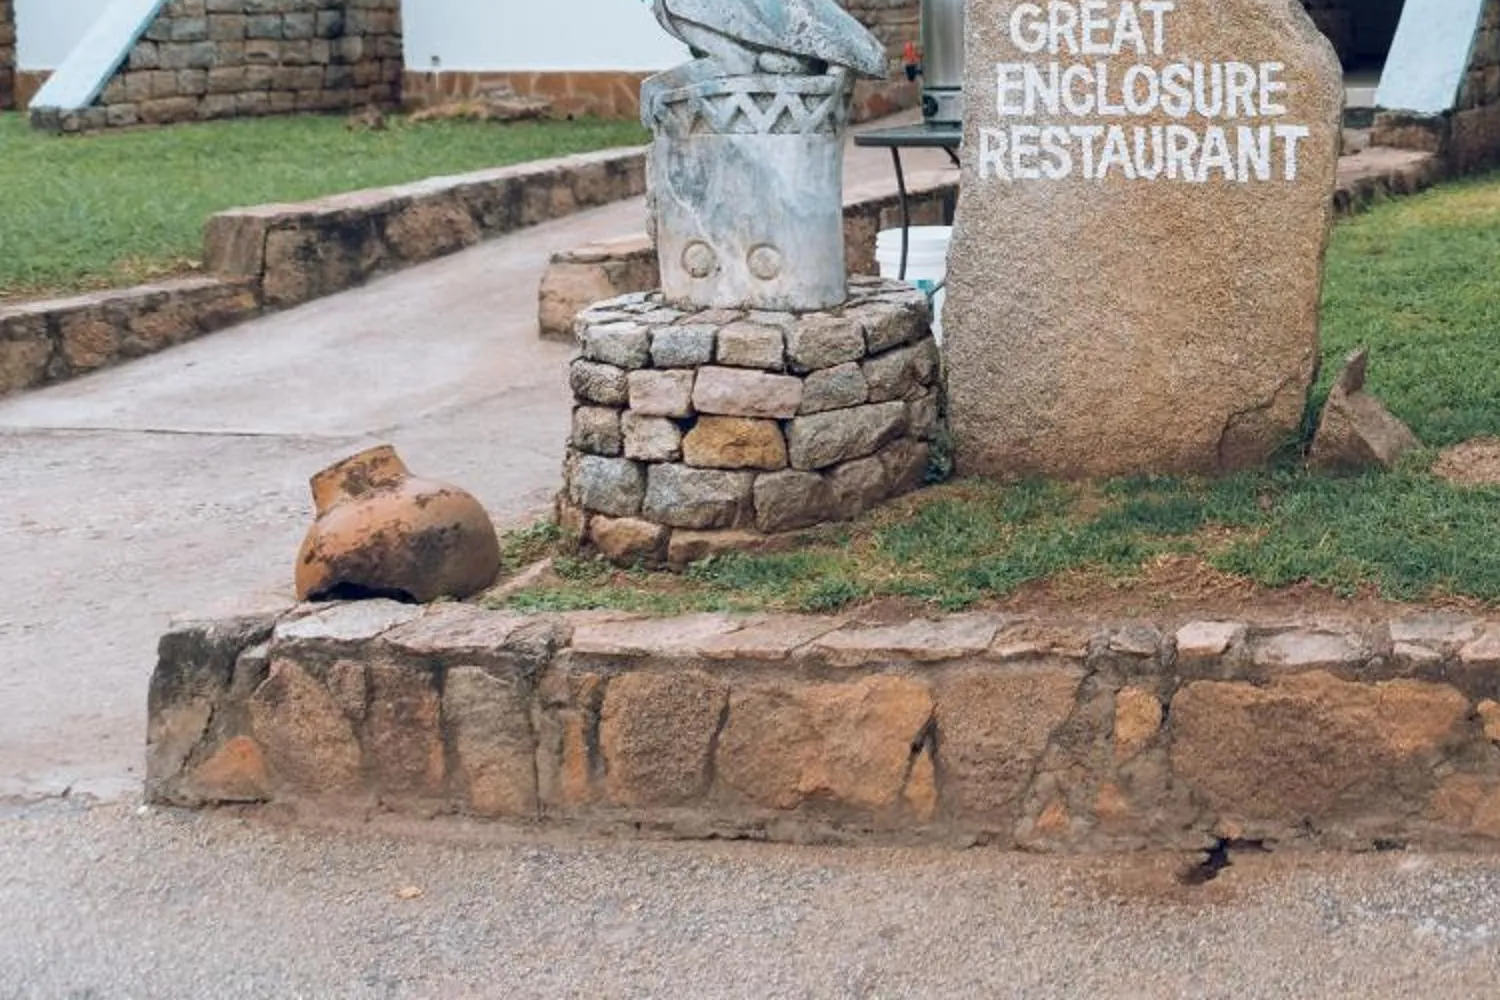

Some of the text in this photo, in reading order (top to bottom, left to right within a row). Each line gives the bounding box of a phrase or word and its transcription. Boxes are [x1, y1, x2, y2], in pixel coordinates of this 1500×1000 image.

[1009, 0, 1174, 55] GREAT
[996, 61, 1287, 118] ENCLOSURE
[978, 124, 1310, 182] RESTAURANT
